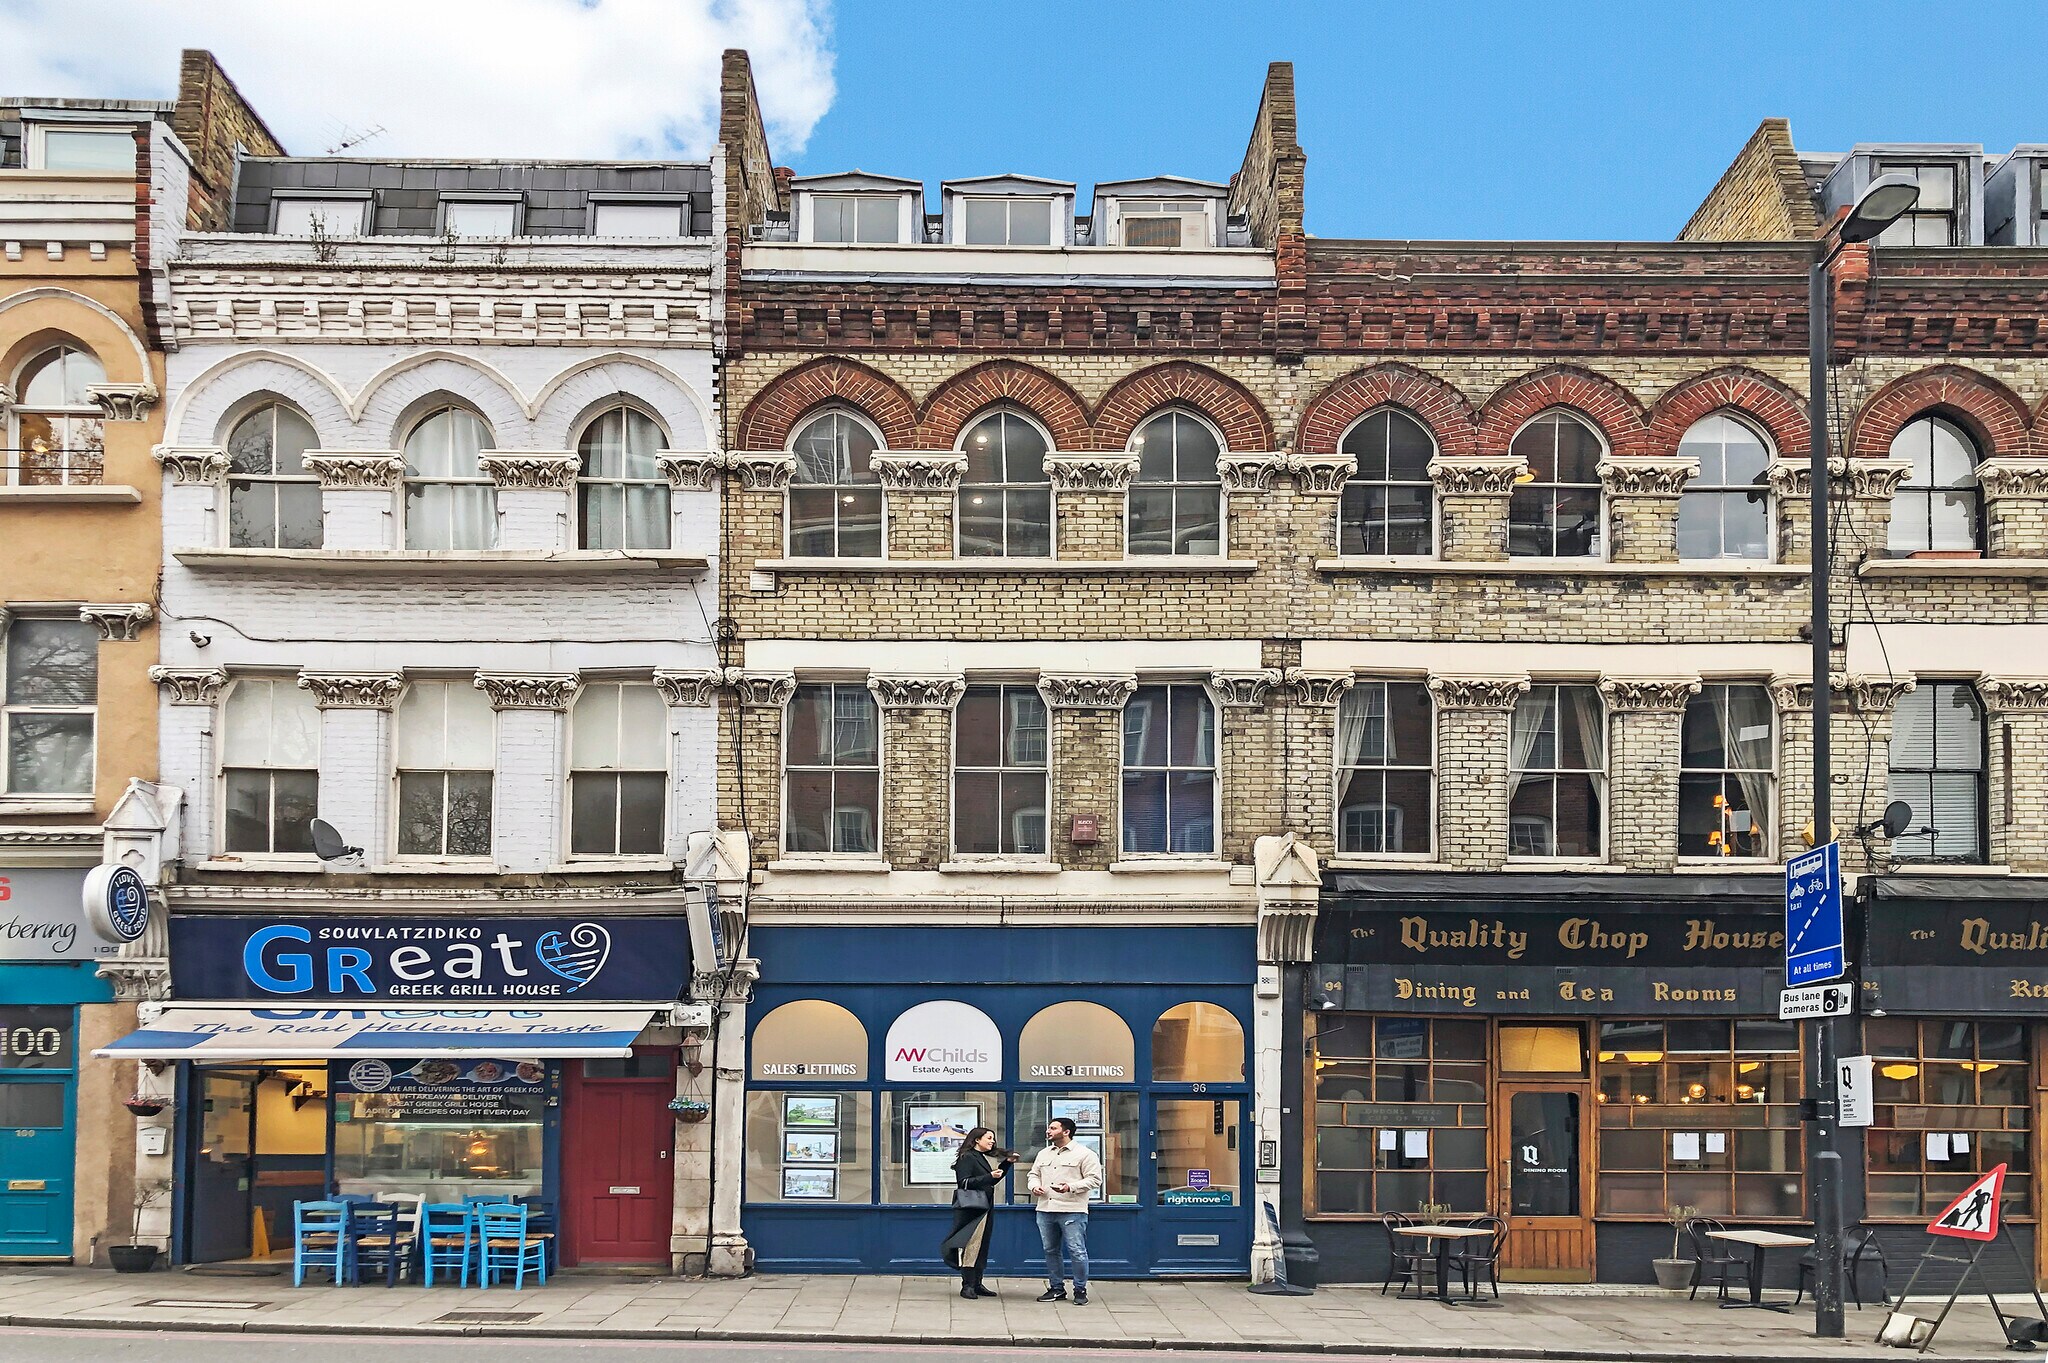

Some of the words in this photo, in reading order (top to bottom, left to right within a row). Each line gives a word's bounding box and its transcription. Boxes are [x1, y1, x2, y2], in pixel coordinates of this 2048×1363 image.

[119, 874, 136, 886] LOVE
[1790, 900, 1802, 911] taxi
[113, 910, 132, 933] GREEK
[133, 908, 146, 931] FOOD
[318, 926, 482, 940] SOUVLATZIDIKO
[1351, 927, 1376, 939] The
[1400, 915, 1528, 959] Quality
[1557, 917, 1649, 959] Chop
[1683, 919, 1785, 951] House
[1910, 929, 1936, 940] The
[1793, 966, 1802, 976] At
[1803, 963, 1812, 973] all
[1813, 960, 1832, 971] times
[389, 983, 444, 996] GREEK
[449, 983, 497, 996] GRILL
[502, 983, 561, 996] HOUSE
[1324, 981, 1342, 991] 94
[1863, 981, 1879, 990] 92
[1394, 978, 1477, 1007] Dining
[1496, 988, 1530, 1000] and
[1558, 981, 1614, 1001] Tea
[1652, 981, 1737, 1001] Rooms
[1783, 993, 1800, 1003] Bus
[1801, 991, 1820, 1001] lane
[1783, 1003, 1820, 1014] cameras
[192, 1022, 259, 1033] The
[267, 1022, 351, 1033] Real
[359, 1021, 512, 1033] Hellenic
[521, 1023, 612, 1034] Taste
[912, 1065, 940, 1073] Estate
[942, 1065, 974, 1075] Agents
[1192, 1083, 1207, 1093] 96
[1167, 1195, 1221, 1205] rightmove
